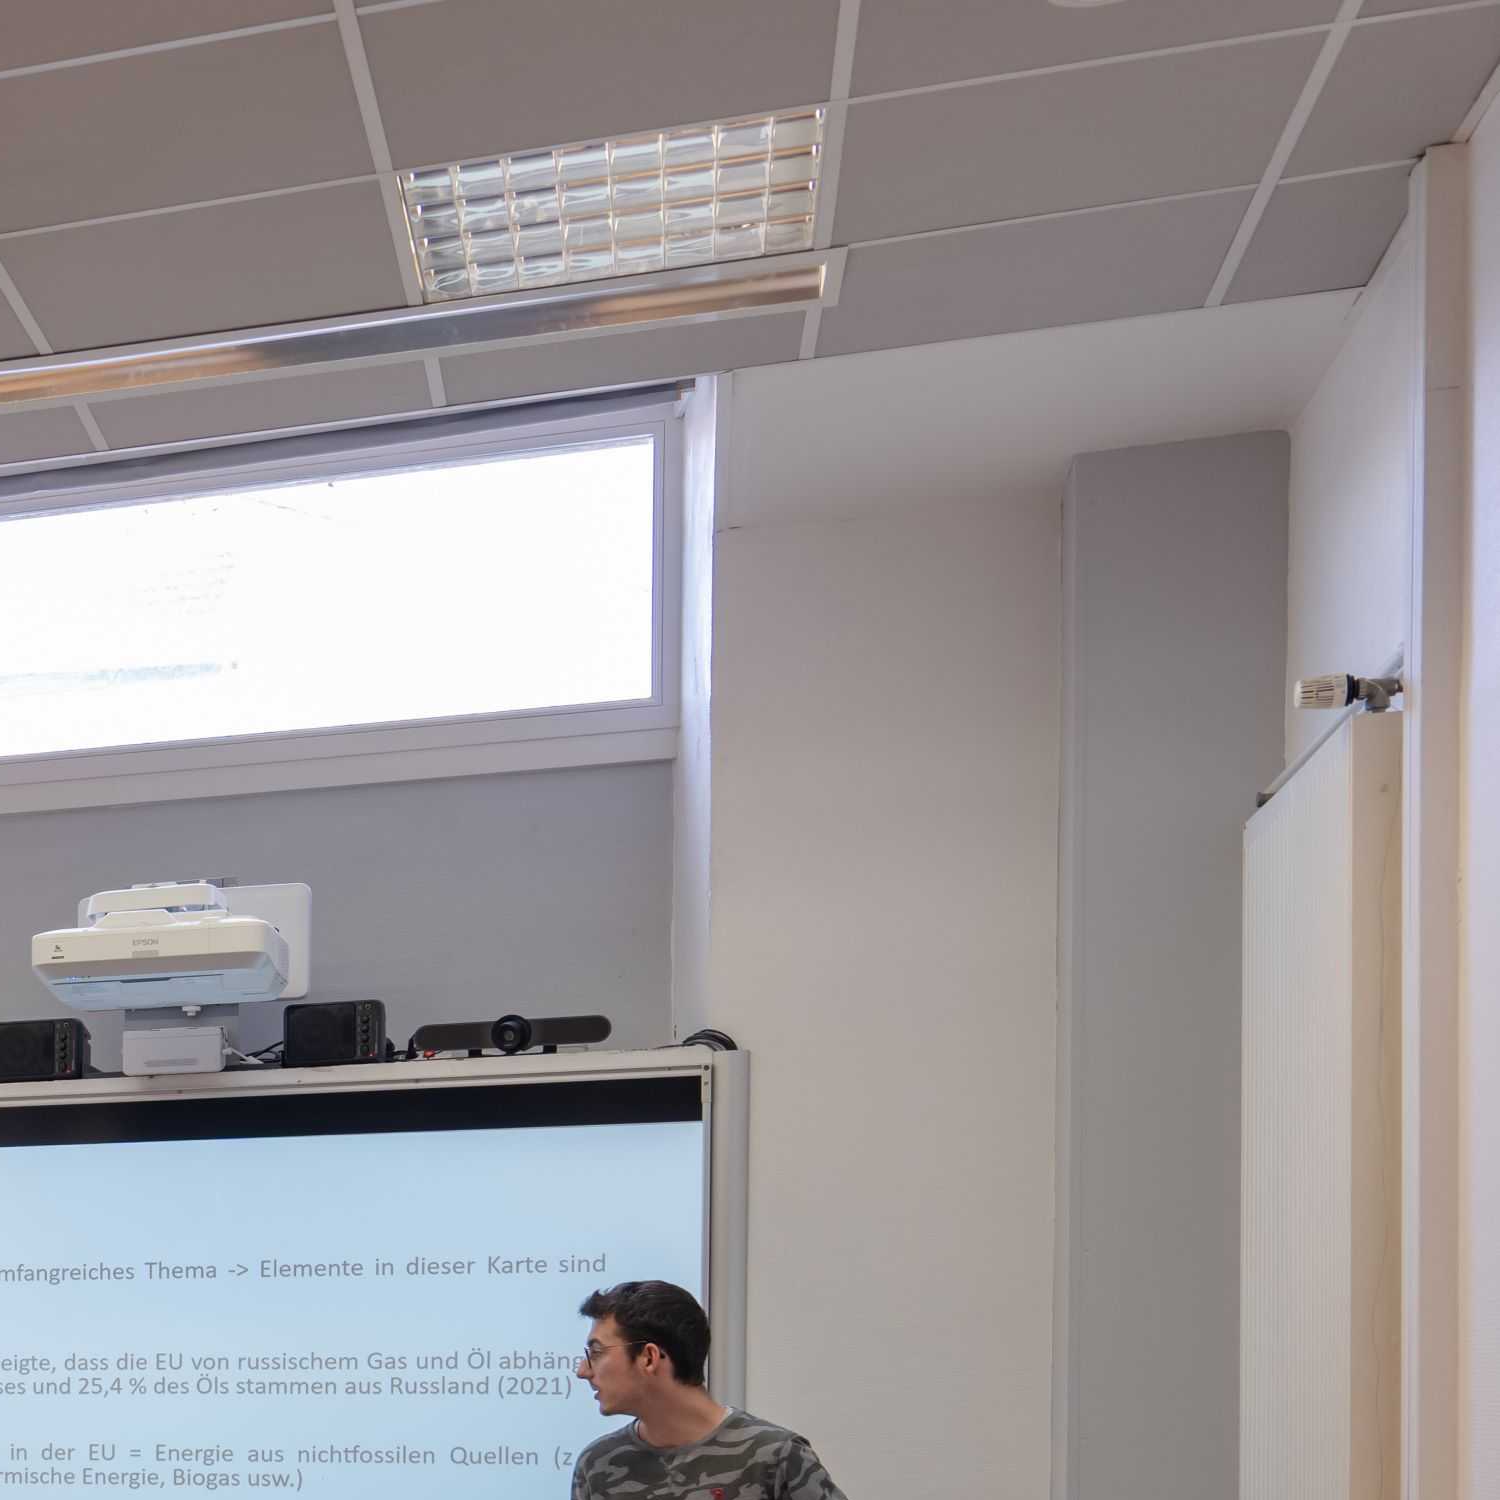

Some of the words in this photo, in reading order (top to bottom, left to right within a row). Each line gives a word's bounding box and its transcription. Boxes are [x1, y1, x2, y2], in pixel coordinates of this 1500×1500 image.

[143, 1260, 217, 1281] Thema
[260, 1258, 364, 1279] Elemente
[375, 1257, 395, 1277] in
[405, 1255, 477, 1276] dieser
[487, 1255, 548, 1275] Karte
[558, 1252, 607, 1274] sind
[64, 1352, 110, 1372] dass
[115, 1351, 148, 1371] die
[155, 1351, 183, 1371] EU
[191, 1356, 230, 1371] von
[237, 1351, 359, 1371] russischem
[366, 1351, 408, 1371] Gas
[416, 1350, 459, 1371] und
[466, 1347, 492, 1370] Öl
[32, 1375, 72, 1396] und
[77, 1376, 124, 1399] 25,4
[128, 1376, 148, 1396] %
[153, 1375, 190, 1395] des
[196, 1372, 230, 1395] Öls
[235, 1377, 337, 1396] stammen
[344, 1380, 383, 1396] aus
[389, 1375, 490, 1396] Russland
[497, 1375, 572, 1400] (2021)
[9, 1443, 28, 1462] in
[40, 1442, 77, 1462] der
[88, 1443, 116, 1462] EU
[155, 1443, 235, 1467] Energie
[247, 1448, 285, 1464] aus
[297, 1443, 436, 1465] nichtfossilen
[449, 1445, 539, 1467] Quellen
[82, 1467, 165, 1490] Energie,
[172, 1468, 241, 1491] Biogas
[247, 1468, 303, 1493] usw.)
